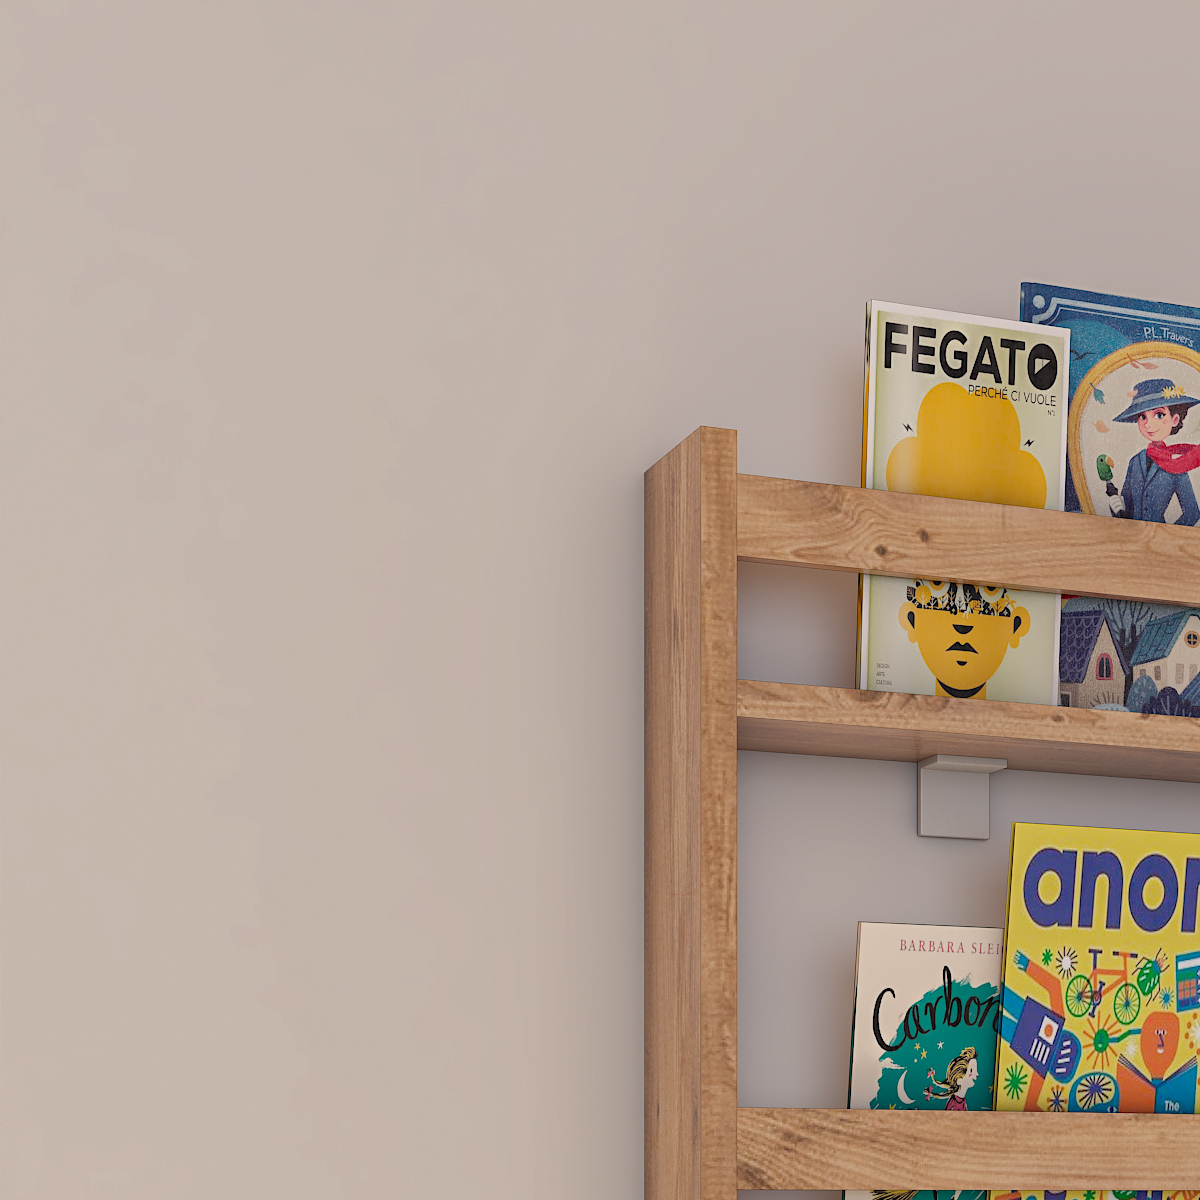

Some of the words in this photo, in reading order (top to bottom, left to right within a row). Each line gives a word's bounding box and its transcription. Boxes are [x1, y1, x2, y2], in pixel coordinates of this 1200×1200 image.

[884, 320, 1058, 391] FEGATO
[968, 384, 1008, 400] PERCHÉ
[1010, 390, 1020, 402] CI
[1023, 392, 1056, 407] VUOLE
[900, 939, 965, 953] BARBARA
[971, 942, 1003, 955] SLEI
[1164, 1100, 1180, 1111] The
